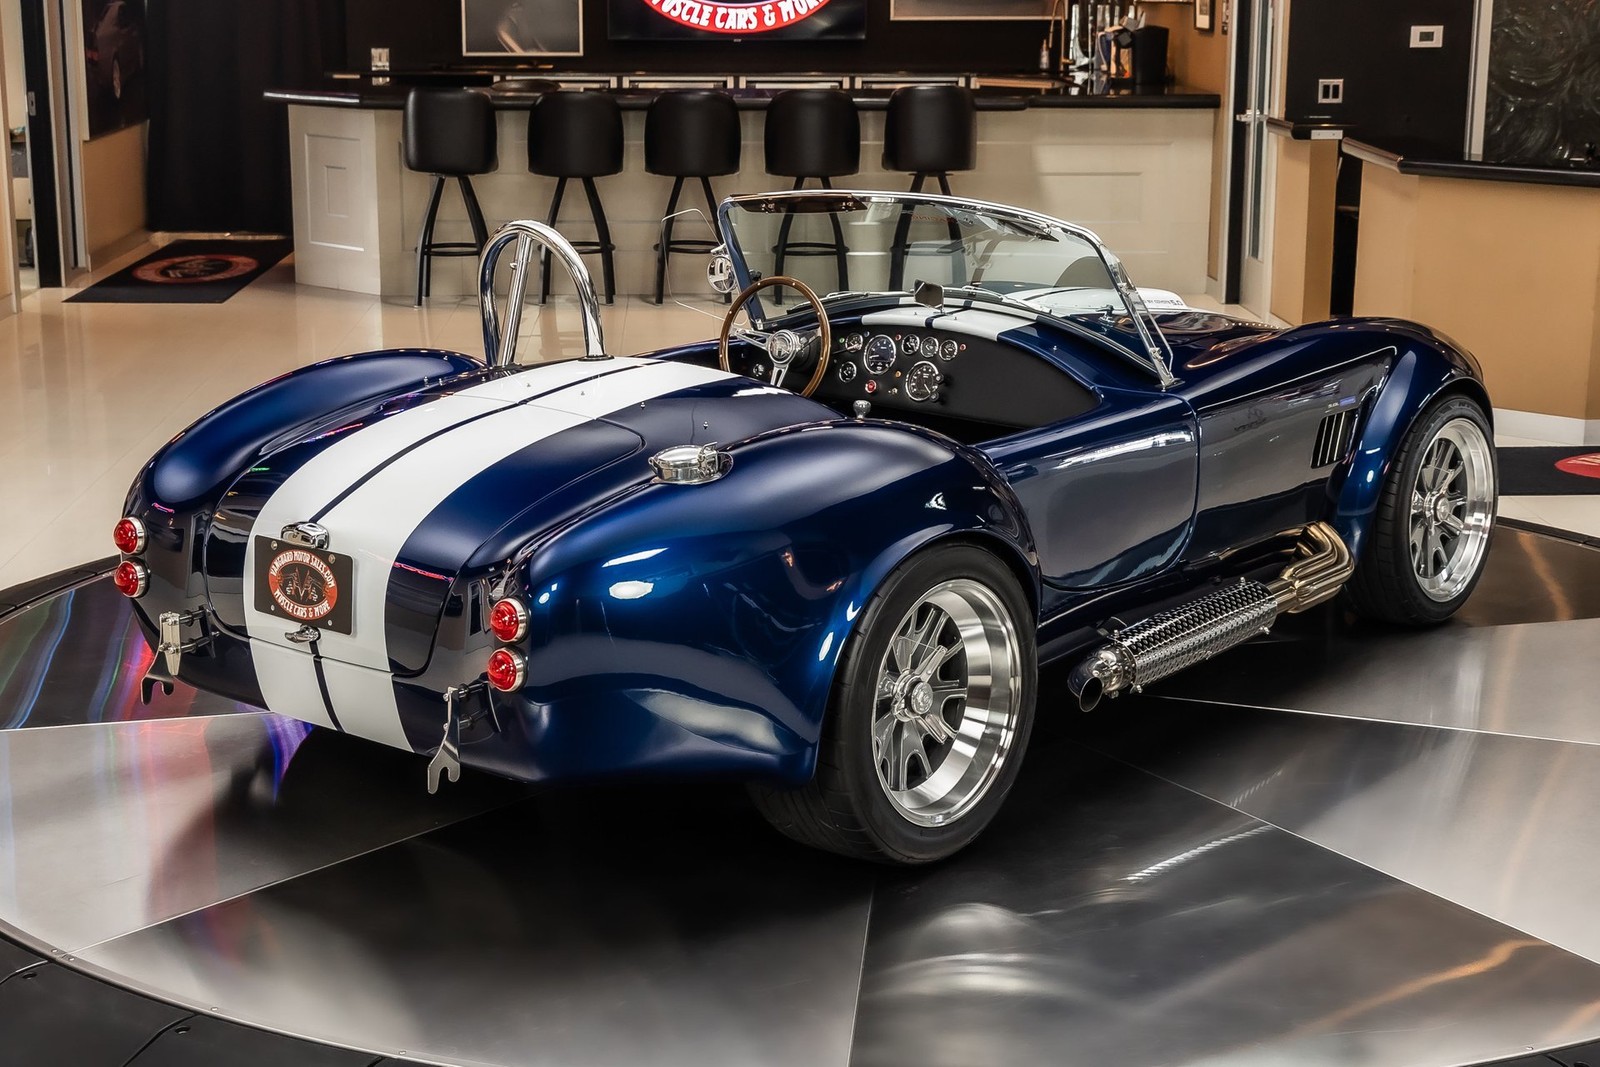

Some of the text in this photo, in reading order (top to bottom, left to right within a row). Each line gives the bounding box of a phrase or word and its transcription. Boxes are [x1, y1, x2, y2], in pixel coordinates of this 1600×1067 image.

[652, 0, 824, 30] USCLE CARS & MO
[270, 550, 335, 588] VANGUARD MOTOR SALES.COM
[274, 588, 331, 618] MUSCLE CARS & MORE
